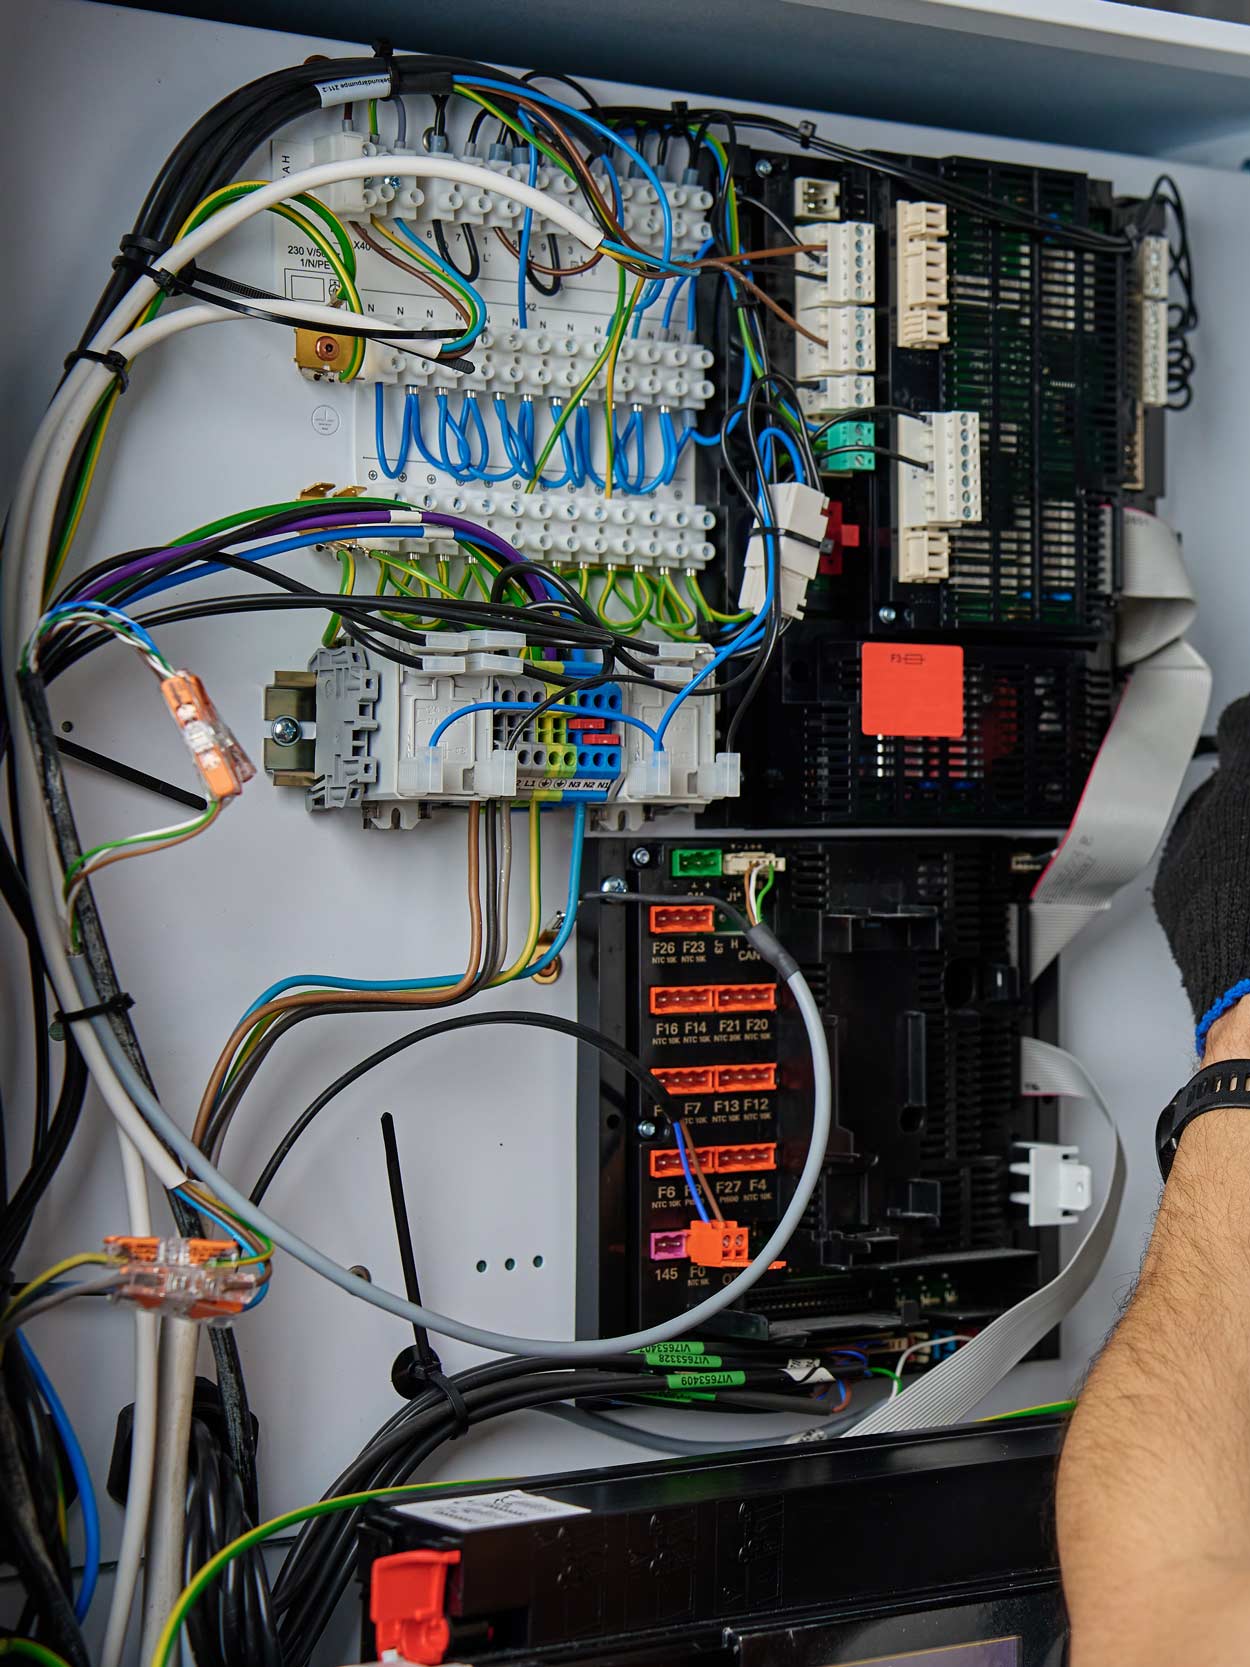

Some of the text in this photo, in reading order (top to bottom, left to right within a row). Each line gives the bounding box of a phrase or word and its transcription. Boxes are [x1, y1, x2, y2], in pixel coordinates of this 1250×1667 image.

[426, 230, 432, 239] 6
[456, 233, 461, 242] 7
[288, 245, 304, 256] 230
[300, 258, 330, 270] 1/N/PE
[368, 304, 375, 312] N
[397, 306, 404, 316] N
[426, 310, 434, 318] N
[526, 302, 536, 312] X2
[568, 780, 581, 788] N3
[652, 940, 705, 955] F26 F23
[655, 1018, 769, 1035] F16 F14 F21 F20
[684, 1102, 701, 1114] F7
[714, 1100, 740, 1112] F13
[743, 1098, 769, 1111] F12
[658, 1186, 676, 1198] F6
[716, 1181, 742, 1194] F27
[750, 1179, 767, 1191] F4
[652, 1201, 667, 1209] NTC
[655, 1268, 678, 1281] 145
[690, 1266, 706, 1278] F0
[658, 1354, 710, 1365] VI7653328
[681, 1374, 733, 1386] VI7653409
